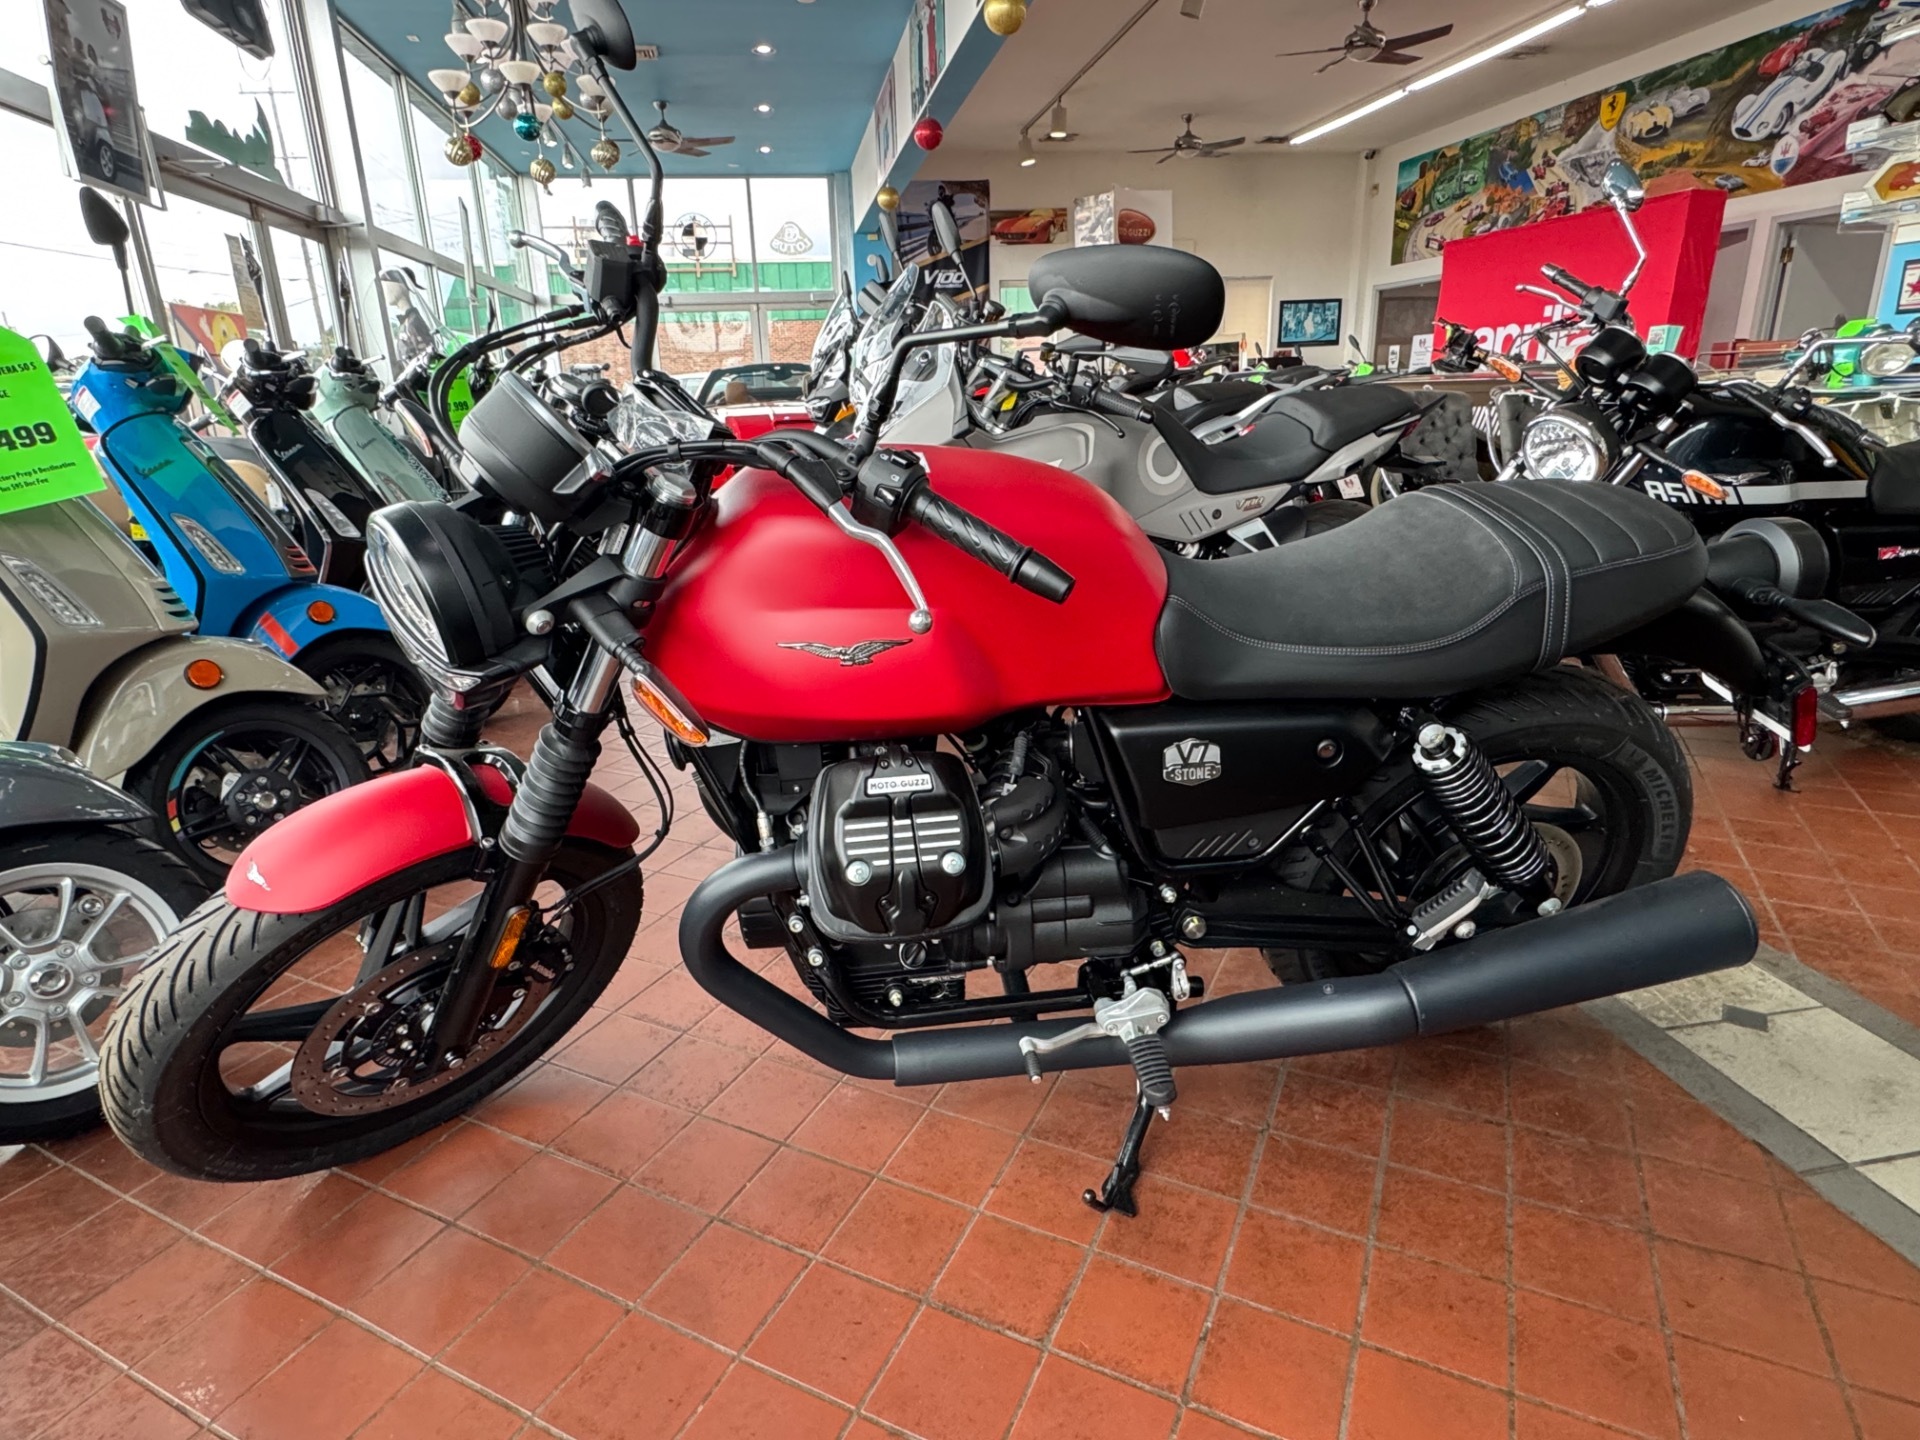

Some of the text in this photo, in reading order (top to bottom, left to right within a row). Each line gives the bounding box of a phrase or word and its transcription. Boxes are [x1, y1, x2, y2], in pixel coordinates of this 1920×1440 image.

[1128, 227, 1151, 237] GUZZI
[924, 269, 965, 285] V100
[17, 362, 30, 372] 50
[29, 361, 37, 371] S
[15, 470, 33, 478] Prep
[38, 461, 77, 474] Destination
[24, 480, 36, 488] Doc
[36, 477, 49, 485] Fee
[1174, 740, 1210, 766] V7
[1174, 766, 1211, 781] STONE
[870, 778, 929, 791] MOTO GUZZI
[1642, 768, 1676, 848] MICHELIN
